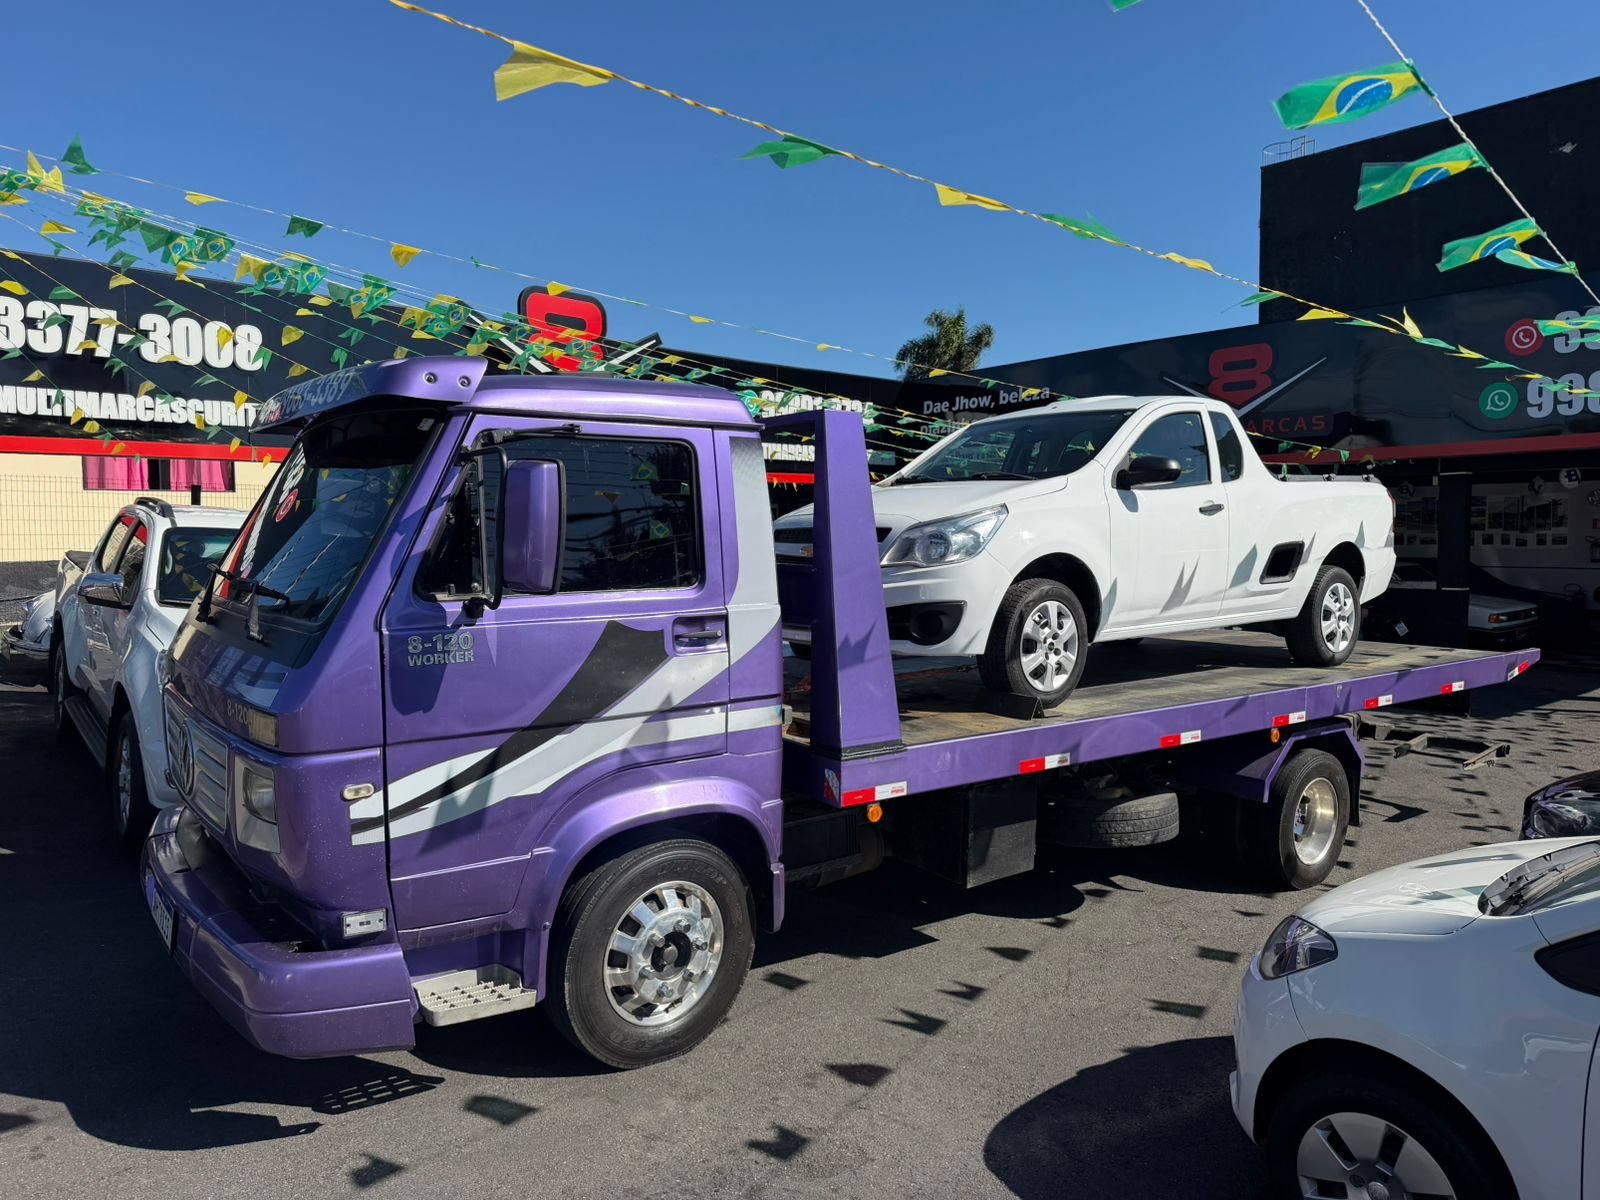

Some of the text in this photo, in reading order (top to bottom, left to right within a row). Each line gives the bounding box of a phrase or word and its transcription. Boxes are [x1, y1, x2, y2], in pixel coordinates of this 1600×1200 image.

[1208, 342, 1273, 406] 8
[923, 400, 950, 415] Dae
[951, 394, 995, 412] Jhow,
[407, 632, 474, 654] 8-120
[407, 651, 475, 667] WORKER
